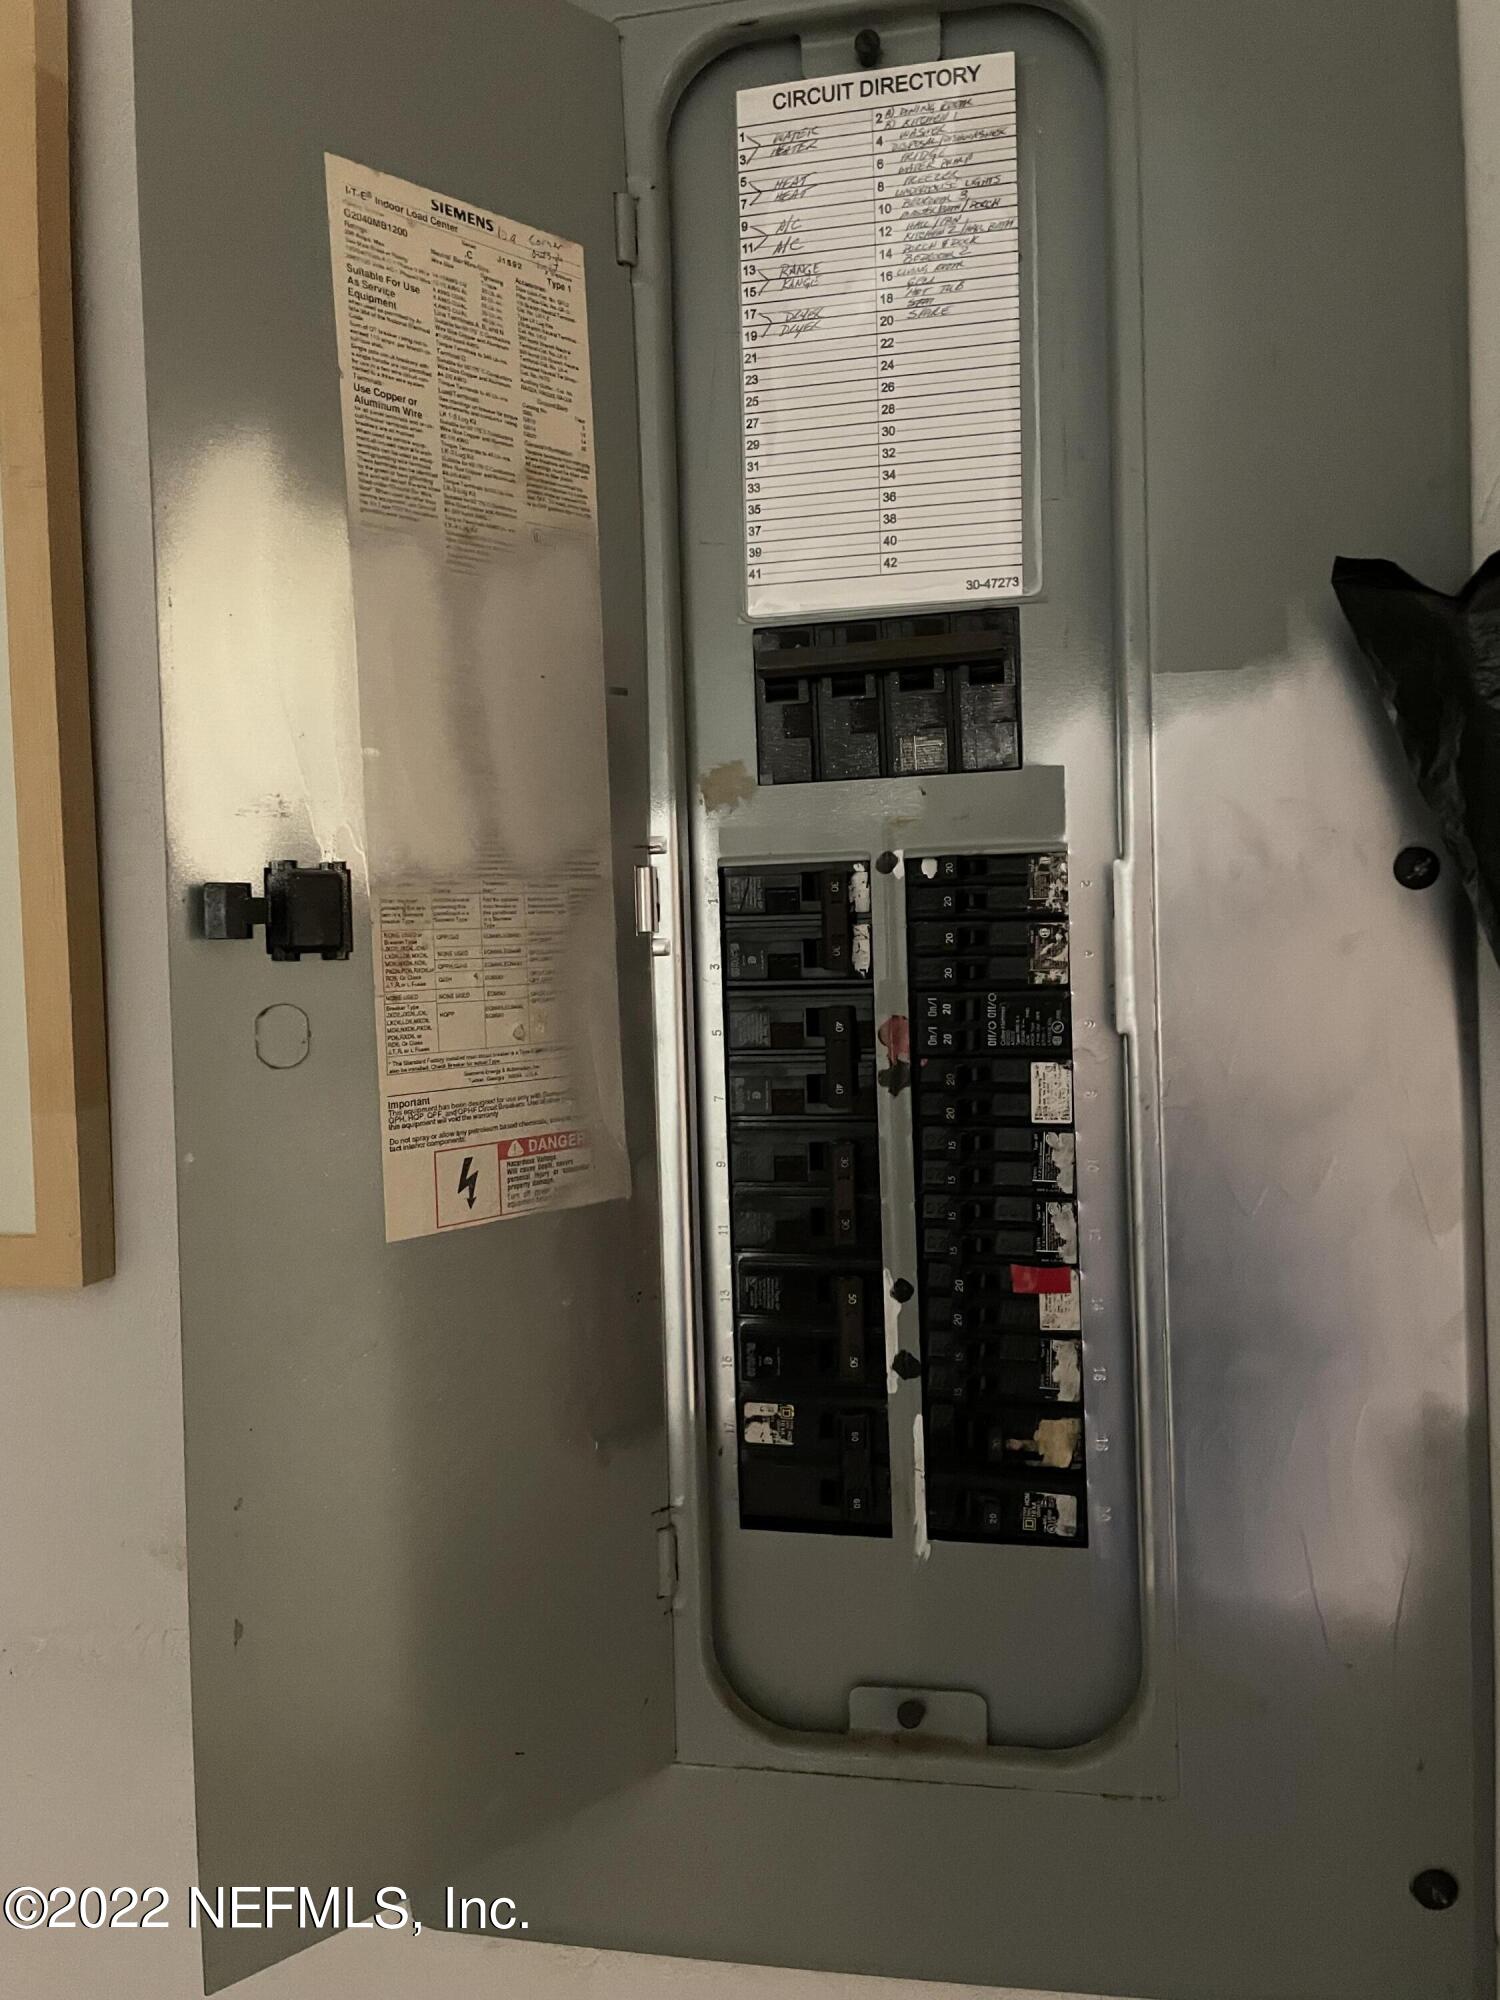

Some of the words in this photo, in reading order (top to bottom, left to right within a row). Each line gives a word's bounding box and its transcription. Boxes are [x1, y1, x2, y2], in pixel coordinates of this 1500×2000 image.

[773, 83, 854, 110] CIRCUIT
[860, 64, 981, 98] DIRECTORY
[876, 113, 883, 123] 2
[740, 132, 746, 143] 1
[876, 136, 883, 146] 4
[740, 154, 747, 165] 3
[900, 149, 944, 163] FRIDGE
[877, 159, 884, 169] 6
[741, 177, 748, 187] 5
[775, 172, 816, 189] HEAT
[877, 182, 884, 192] 8
[741, 199, 748, 210] 7
[879, 204, 892, 214] 10
[375, 197, 404, 213] Indoor
[407, 208, 428, 223] Load
[430, 217, 458, 233] Center
[430, 198, 494, 232] SIEMENS
[742, 221, 748, 232] 9
[879, 226, 892, 237] 12
[742, 243, 754, 254] 11
[773, 236, 804, 255] A/C
[959, 246, 971, 256] 2
[879, 249, 892, 259] 14
[744, 265, 756, 276] 13
[779, 262, 823, 279] RANGE
[347, 263, 384, 283] Suitable
[386, 276, 400, 288] For
[404, 281, 421, 294] Use
[880, 271, 893, 282] 16
[347, 275, 359, 286] As
[362, 280, 396, 298] Service
[547, 278, 565, 290] Type
[782, 275, 822, 291] RANGE
[940, 281, 965, 293] TUB
[744, 287, 757, 298] 15
[348, 287, 397, 310] Equipment
[880, 293, 893, 304] 18
[745, 309, 757, 320] 17
[880, 315, 894, 326] 20
[745, 331, 758, 342] 19
[880, 338, 894, 348] 22
[745, 353, 757, 364] 21
[880, 360, 895, 371] 24
[745, 375, 759, 386] 23
[881, 382, 895, 392] 26
[354, 383, 371, 394] Use
[373, 387, 406, 404] Copper
[408, 398, 417, 407] or
[354, 394, 401, 414] Aluminum
[403, 406, 423, 420] Wire
[746, 396, 759, 407] 25
[881, 404, 895, 414] 28
[746, 418, 759, 429] 27
[881, 426, 896, 436] 30
[746, 440, 760, 450] 29
[881, 448, 896, 458] 32
[747, 461, 759, 472] 31
[882, 470, 896, 480] 34
[747, 483, 761, 493] 33
[882, 491, 897, 502] 36
[748, 505, 761, 515] 35
[883, 513, 897, 524] 38
[748, 526, 761, 536] 37
[883, 535, 897, 546] 40
[748, 547, 762, 557] 39
[883, 557, 898, 568] 42
[749, 569, 761, 579] 41
[966, 577, 1020, 591] 30-47273
[945, 862, 954, 873] 20
[831, 880, 840, 893] 30
[943, 896, 952, 908] 20
[945, 932, 954, 944] 20
[709, 963, 720, 971] 3
[944, 967, 953, 979] 20
[942, 1003, 952, 1016] 20
[711, 1028, 722, 1037] 5
[835, 1020, 844, 1034] 40
[943, 1033, 952, 1045] 20
[946, 1073, 956, 1086] 20
[835, 1082, 844, 1095] 40
[388, 1097, 430, 1110] Important
[713, 1095, 724, 1103] 7
[946, 1107, 956, 1120] 20
[401, 1119, 436, 1130] equipment
[389, 1138, 399, 1146] Do
[400, 1136, 410, 1144] not
[947, 1140, 957, 1151] 15
[715, 1160, 727, 1169] 9
[840, 1155, 849, 1169] 30
[947, 1175, 957, 1186] 15
[947, 1210, 957, 1221] 15
[841, 1218, 850, 1231] 30
[717, 1224, 729, 1237] 11
[949, 1246, 958, 1256] 15
[954, 1279, 964, 1293] 20
[719, 1290, 731, 1303] 13
[847, 1292, 857, 1305] 50
[953, 1313, 963, 1328] 20
[849, 1356, 859, 1369] 50
